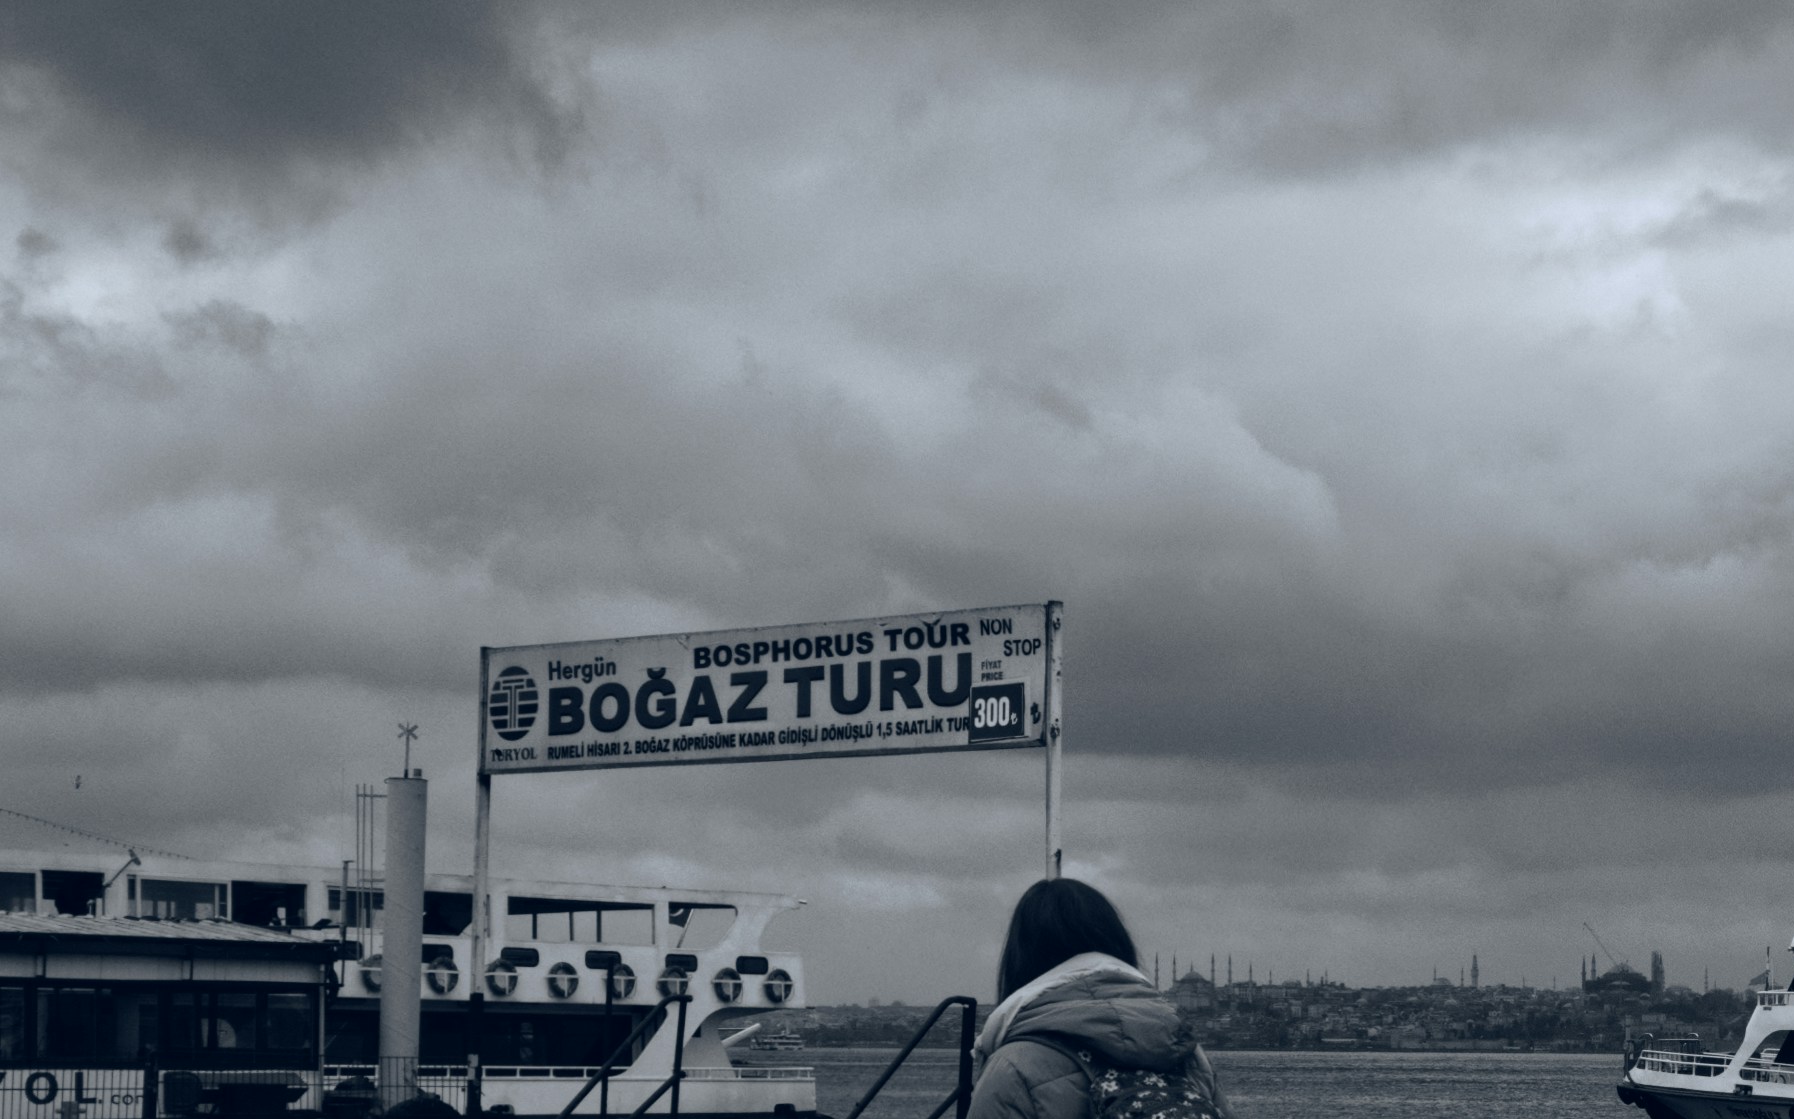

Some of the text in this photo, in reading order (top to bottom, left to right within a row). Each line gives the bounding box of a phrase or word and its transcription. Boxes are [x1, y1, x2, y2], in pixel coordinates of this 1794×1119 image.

[980, 618, 1012, 636] NON
[694, 622, 971, 669] BOSPHORUS TOUR
[1003, 638, 1041, 657] STOP
[548, 657, 616, 684] Hergün
[981, 658, 1002, 671] FİYAT
[981, 671, 1003, 682] PRICE
[548, 653, 972, 736] BOĞAZ TURU
[548, 741, 584, 760] RUMELİ
[587, 739, 620, 758] HİSARI
[623, 741, 632, 755] 2.
[635, 736, 669, 754] BOĞAZ
[673, 732, 735, 752] KÖPRÜSÜNE
[739, 729, 775, 746] KADAR
[779, 724, 818, 747] GİDİŞLİ
[821, 721, 872, 743] DÖNÜŞLÜ
[877, 722, 892, 740] 1,5
[895, 716, 943, 736] SAATLİK
